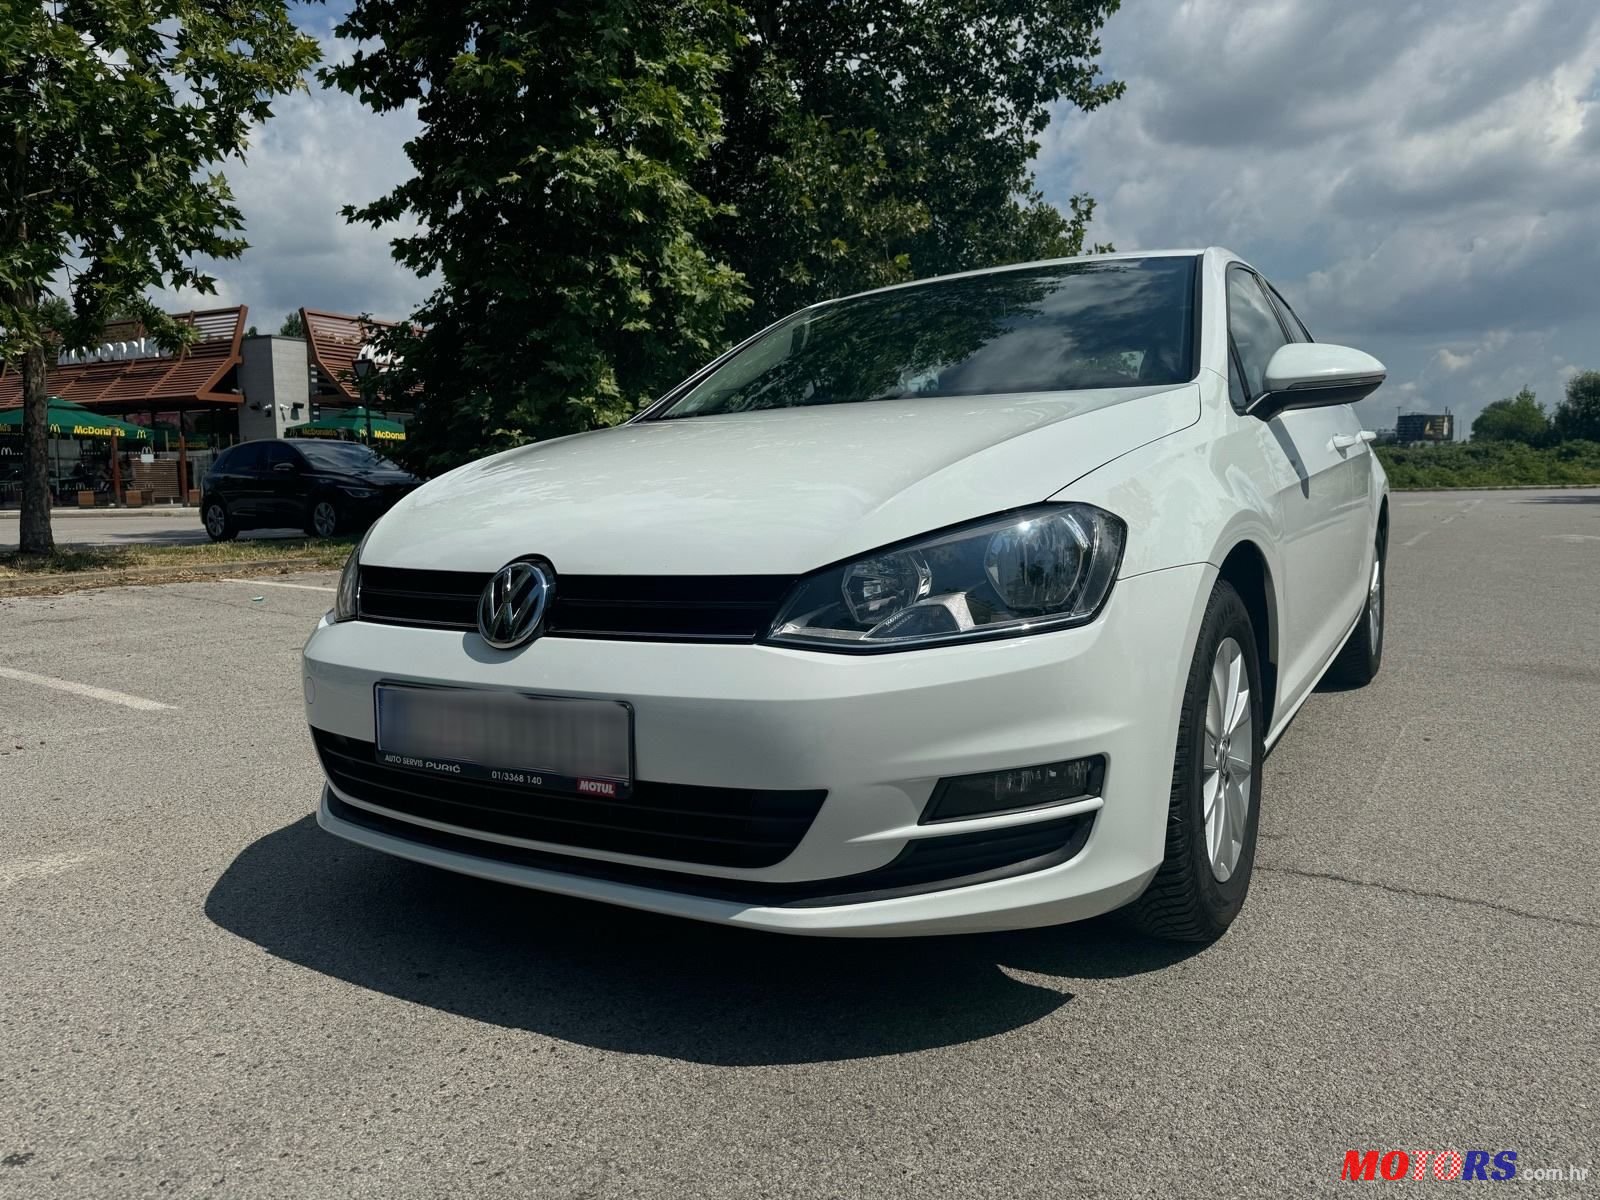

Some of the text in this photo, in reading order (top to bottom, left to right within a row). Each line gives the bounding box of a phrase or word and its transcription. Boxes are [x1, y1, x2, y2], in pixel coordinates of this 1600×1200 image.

[73, 425, 126, 437] McDonad's
[374, 430, 406, 440] McDonal
[385, 754, 402, 764] AUTO
[402, 757, 424, 768] SERVIS
[491, 770, 543, 786] 01/3368 140
[580, 780, 615, 794] MOTUL
